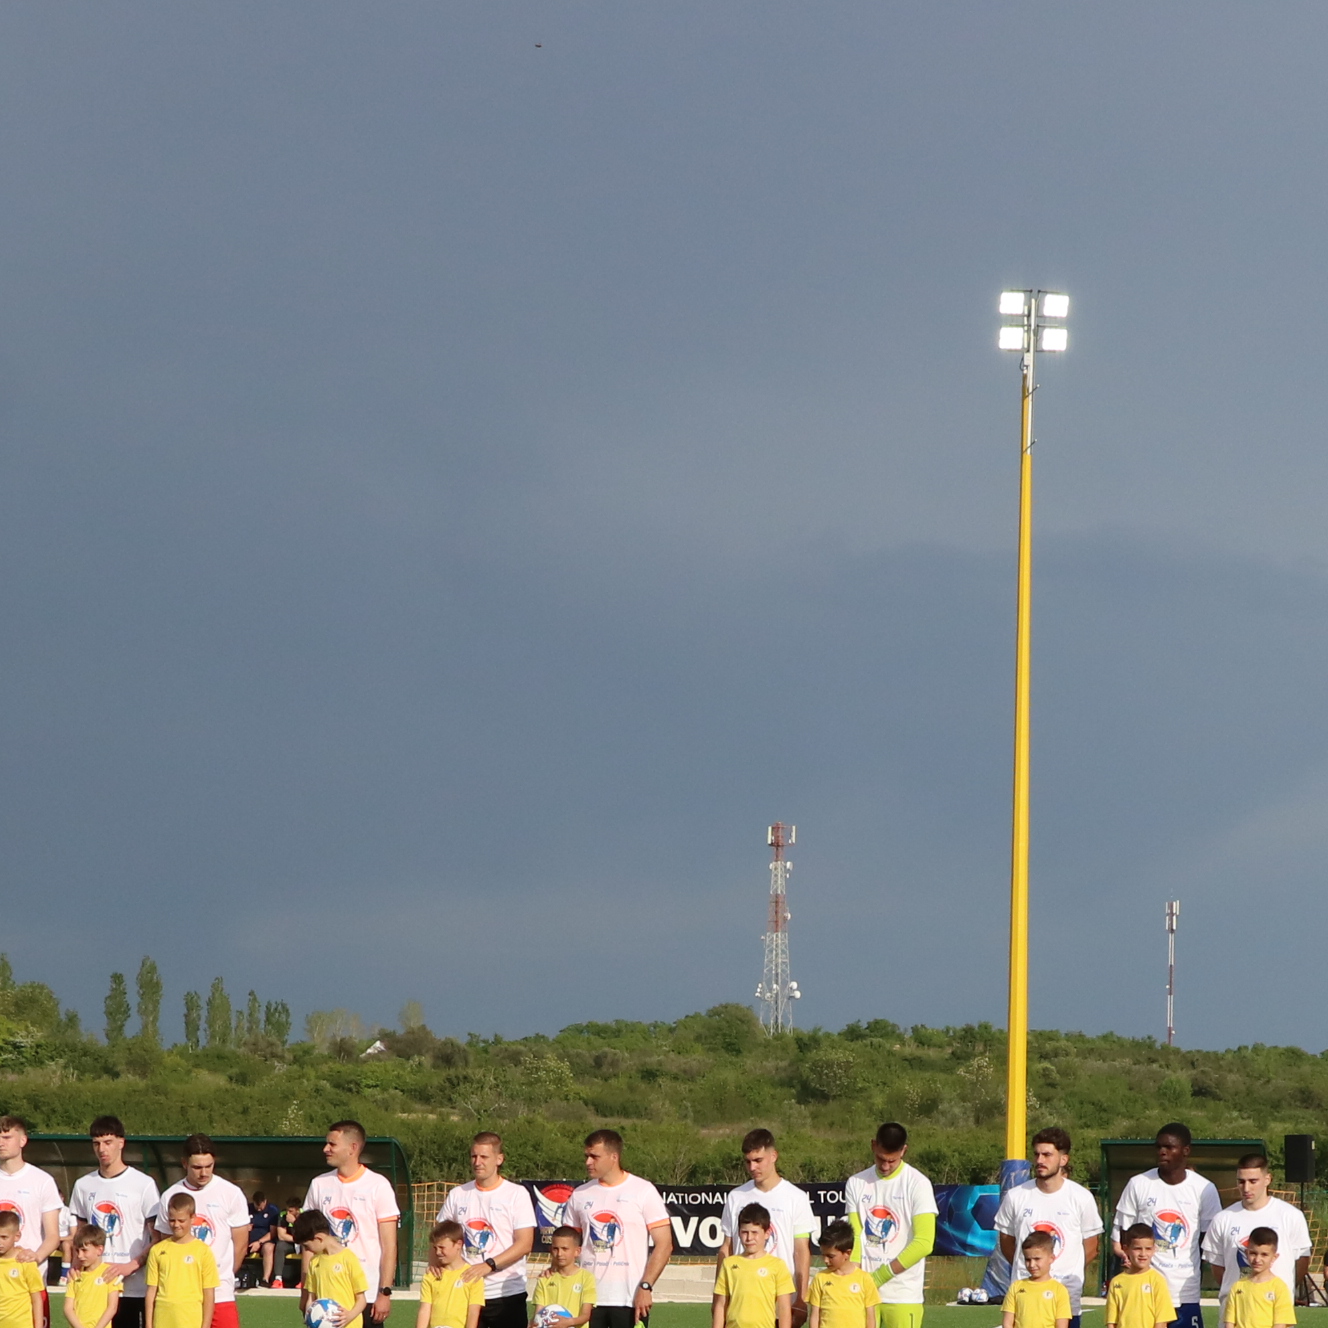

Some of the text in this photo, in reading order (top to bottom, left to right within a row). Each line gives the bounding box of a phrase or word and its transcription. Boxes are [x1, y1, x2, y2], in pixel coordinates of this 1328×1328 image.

[1147, 1197, 1157, 1206] 24
[1023, 1208, 1033, 1217] 24
[1230, 1226, 1241, 1236] 24
